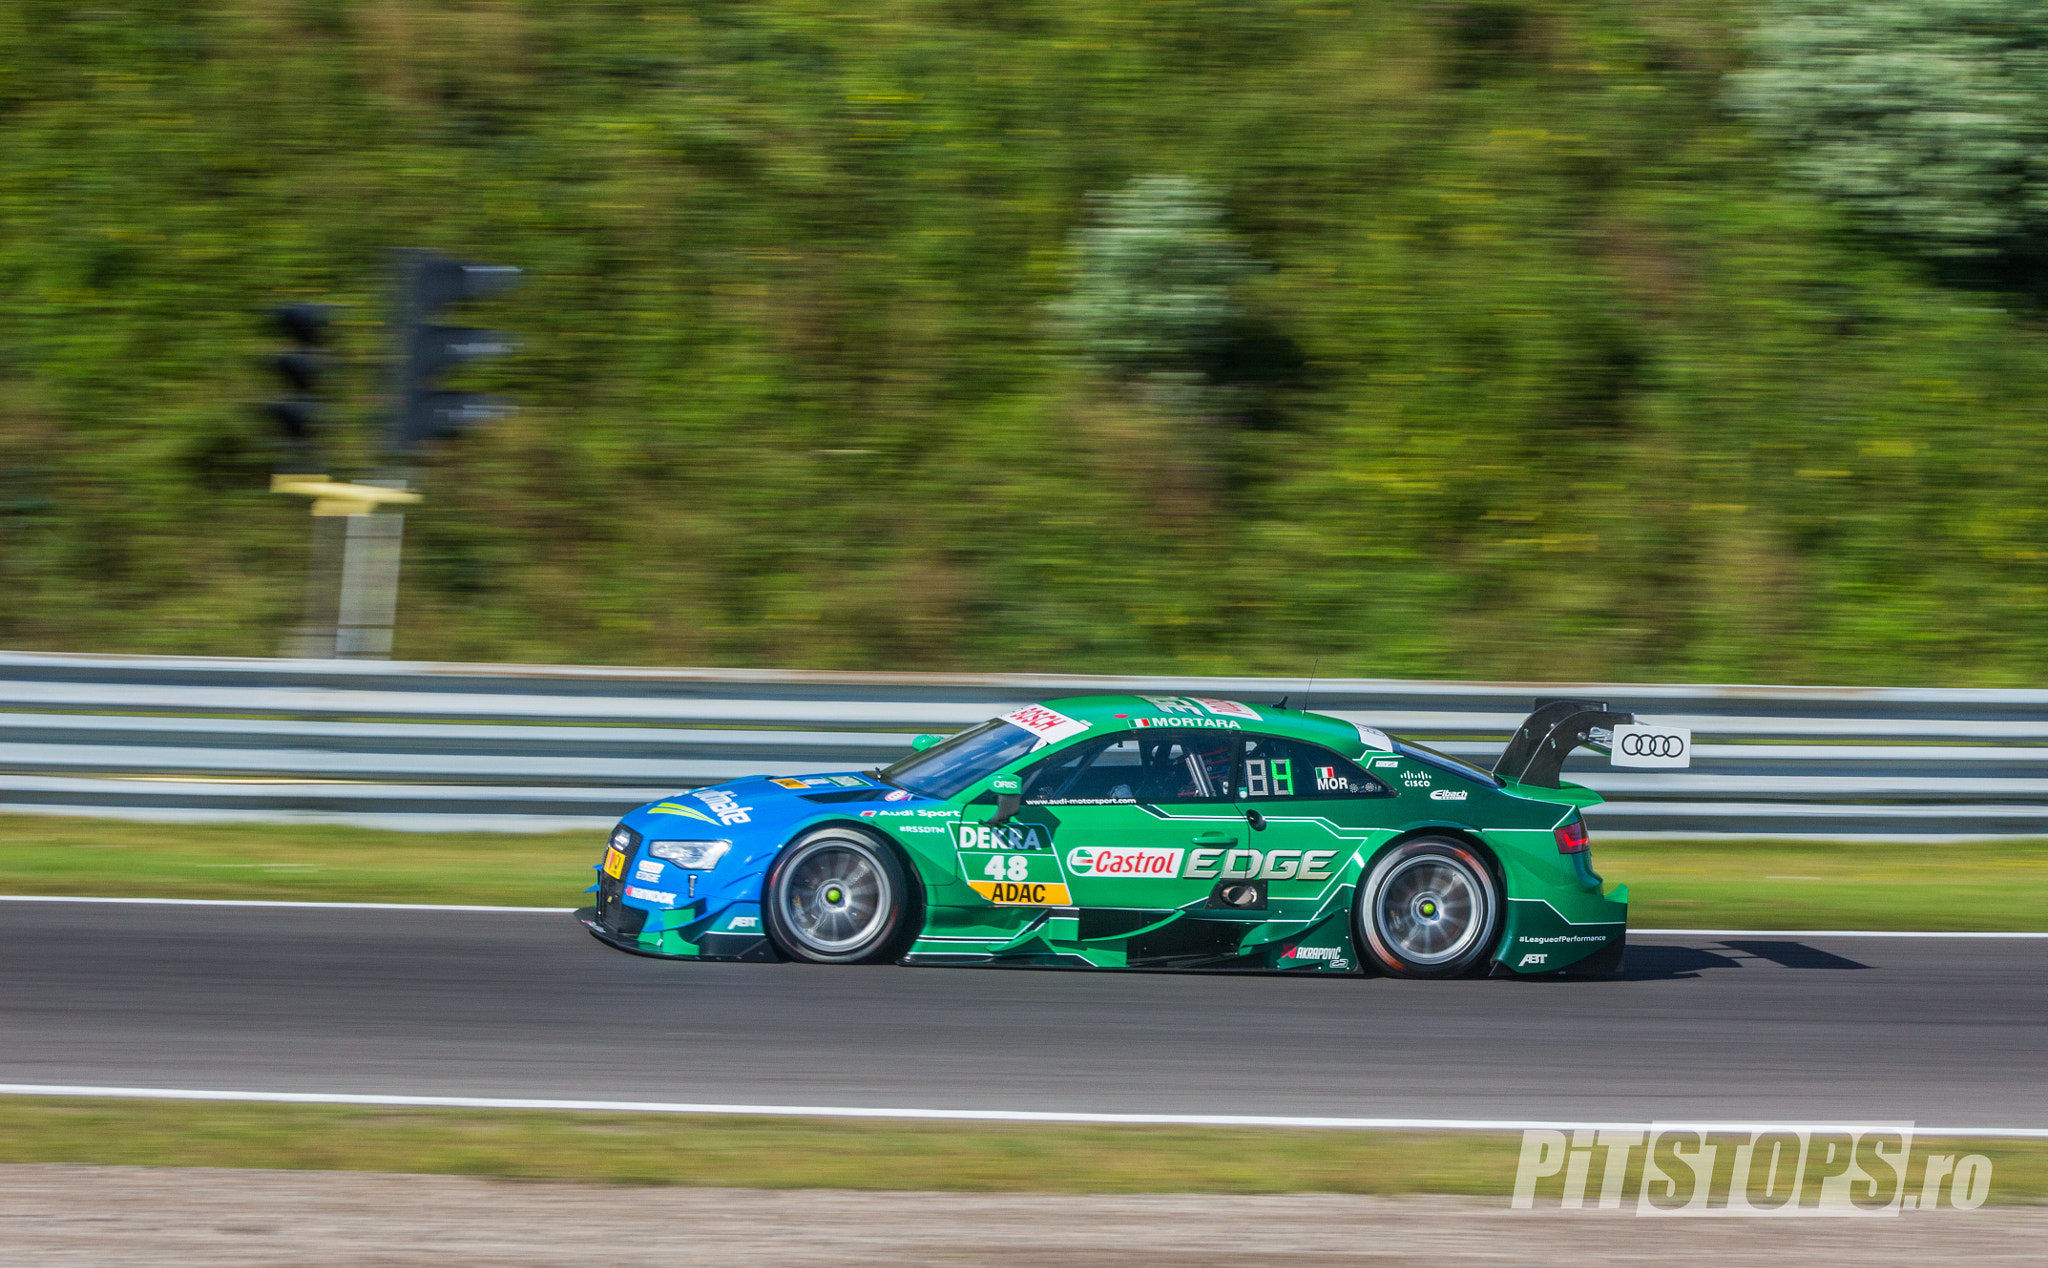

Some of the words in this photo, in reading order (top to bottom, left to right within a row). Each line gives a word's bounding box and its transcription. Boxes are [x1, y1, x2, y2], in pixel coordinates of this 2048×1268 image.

[1010, 707, 1066, 731] BOSCH
[1152, 717, 1241, 729] MORTARA
[993, 780, 1018, 789] ORIS
[1317, 777, 1349, 790] MOR
[1025, 798, 1136, 806] www.audi-motorsport.com
[917, 810, 961, 818] Sport
[959, 826, 1042, 850] DEKRA
[984, 855, 1028, 881] 48
[1095, 850, 1176, 874] Castrol
[1182, 848, 1340, 880] EDGE
[992, 883, 1046, 903] ADAC
[727, 916, 759, 930] ABT
[1519, 934, 1607, 944] #LeagueofPerformance
[1518, 953, 1548, 966] ABT
